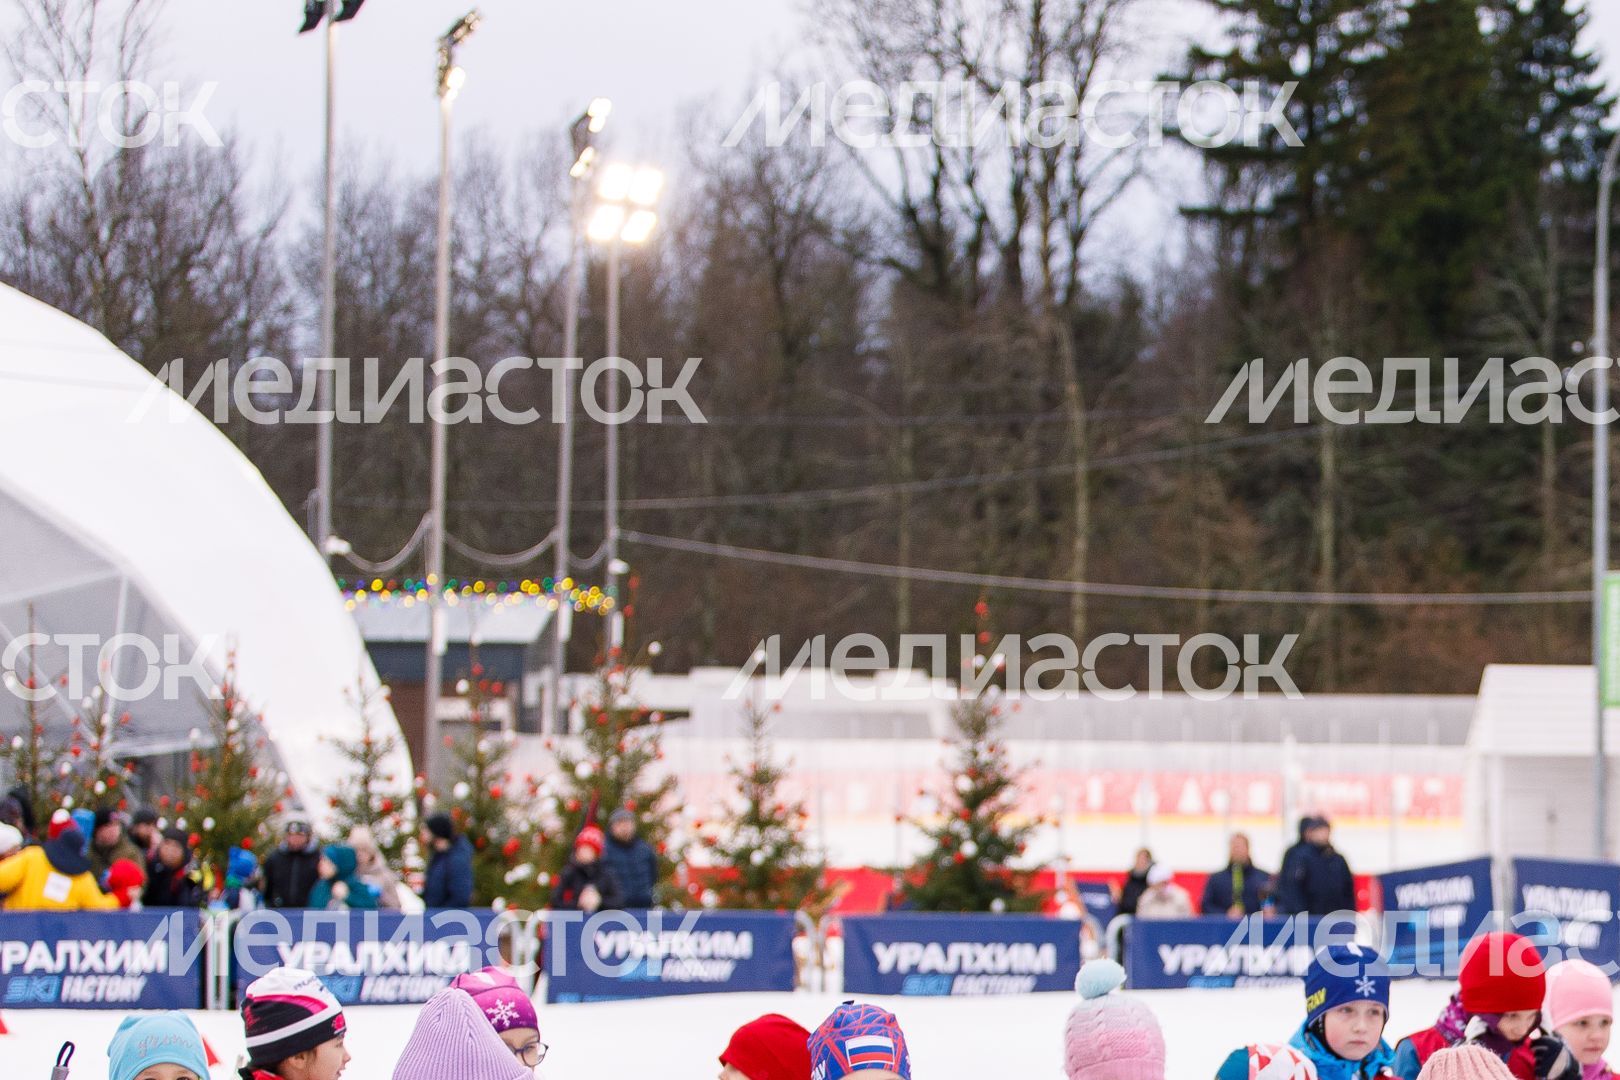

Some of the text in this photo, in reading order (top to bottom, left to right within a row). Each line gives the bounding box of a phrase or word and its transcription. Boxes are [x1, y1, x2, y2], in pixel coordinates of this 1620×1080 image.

[0, 940, 168, 974] РАЛХИМ
[278, 941, 470, 974] УРАЛХИМ
[872, 942, 1056, 974] УРАЛХИМ
